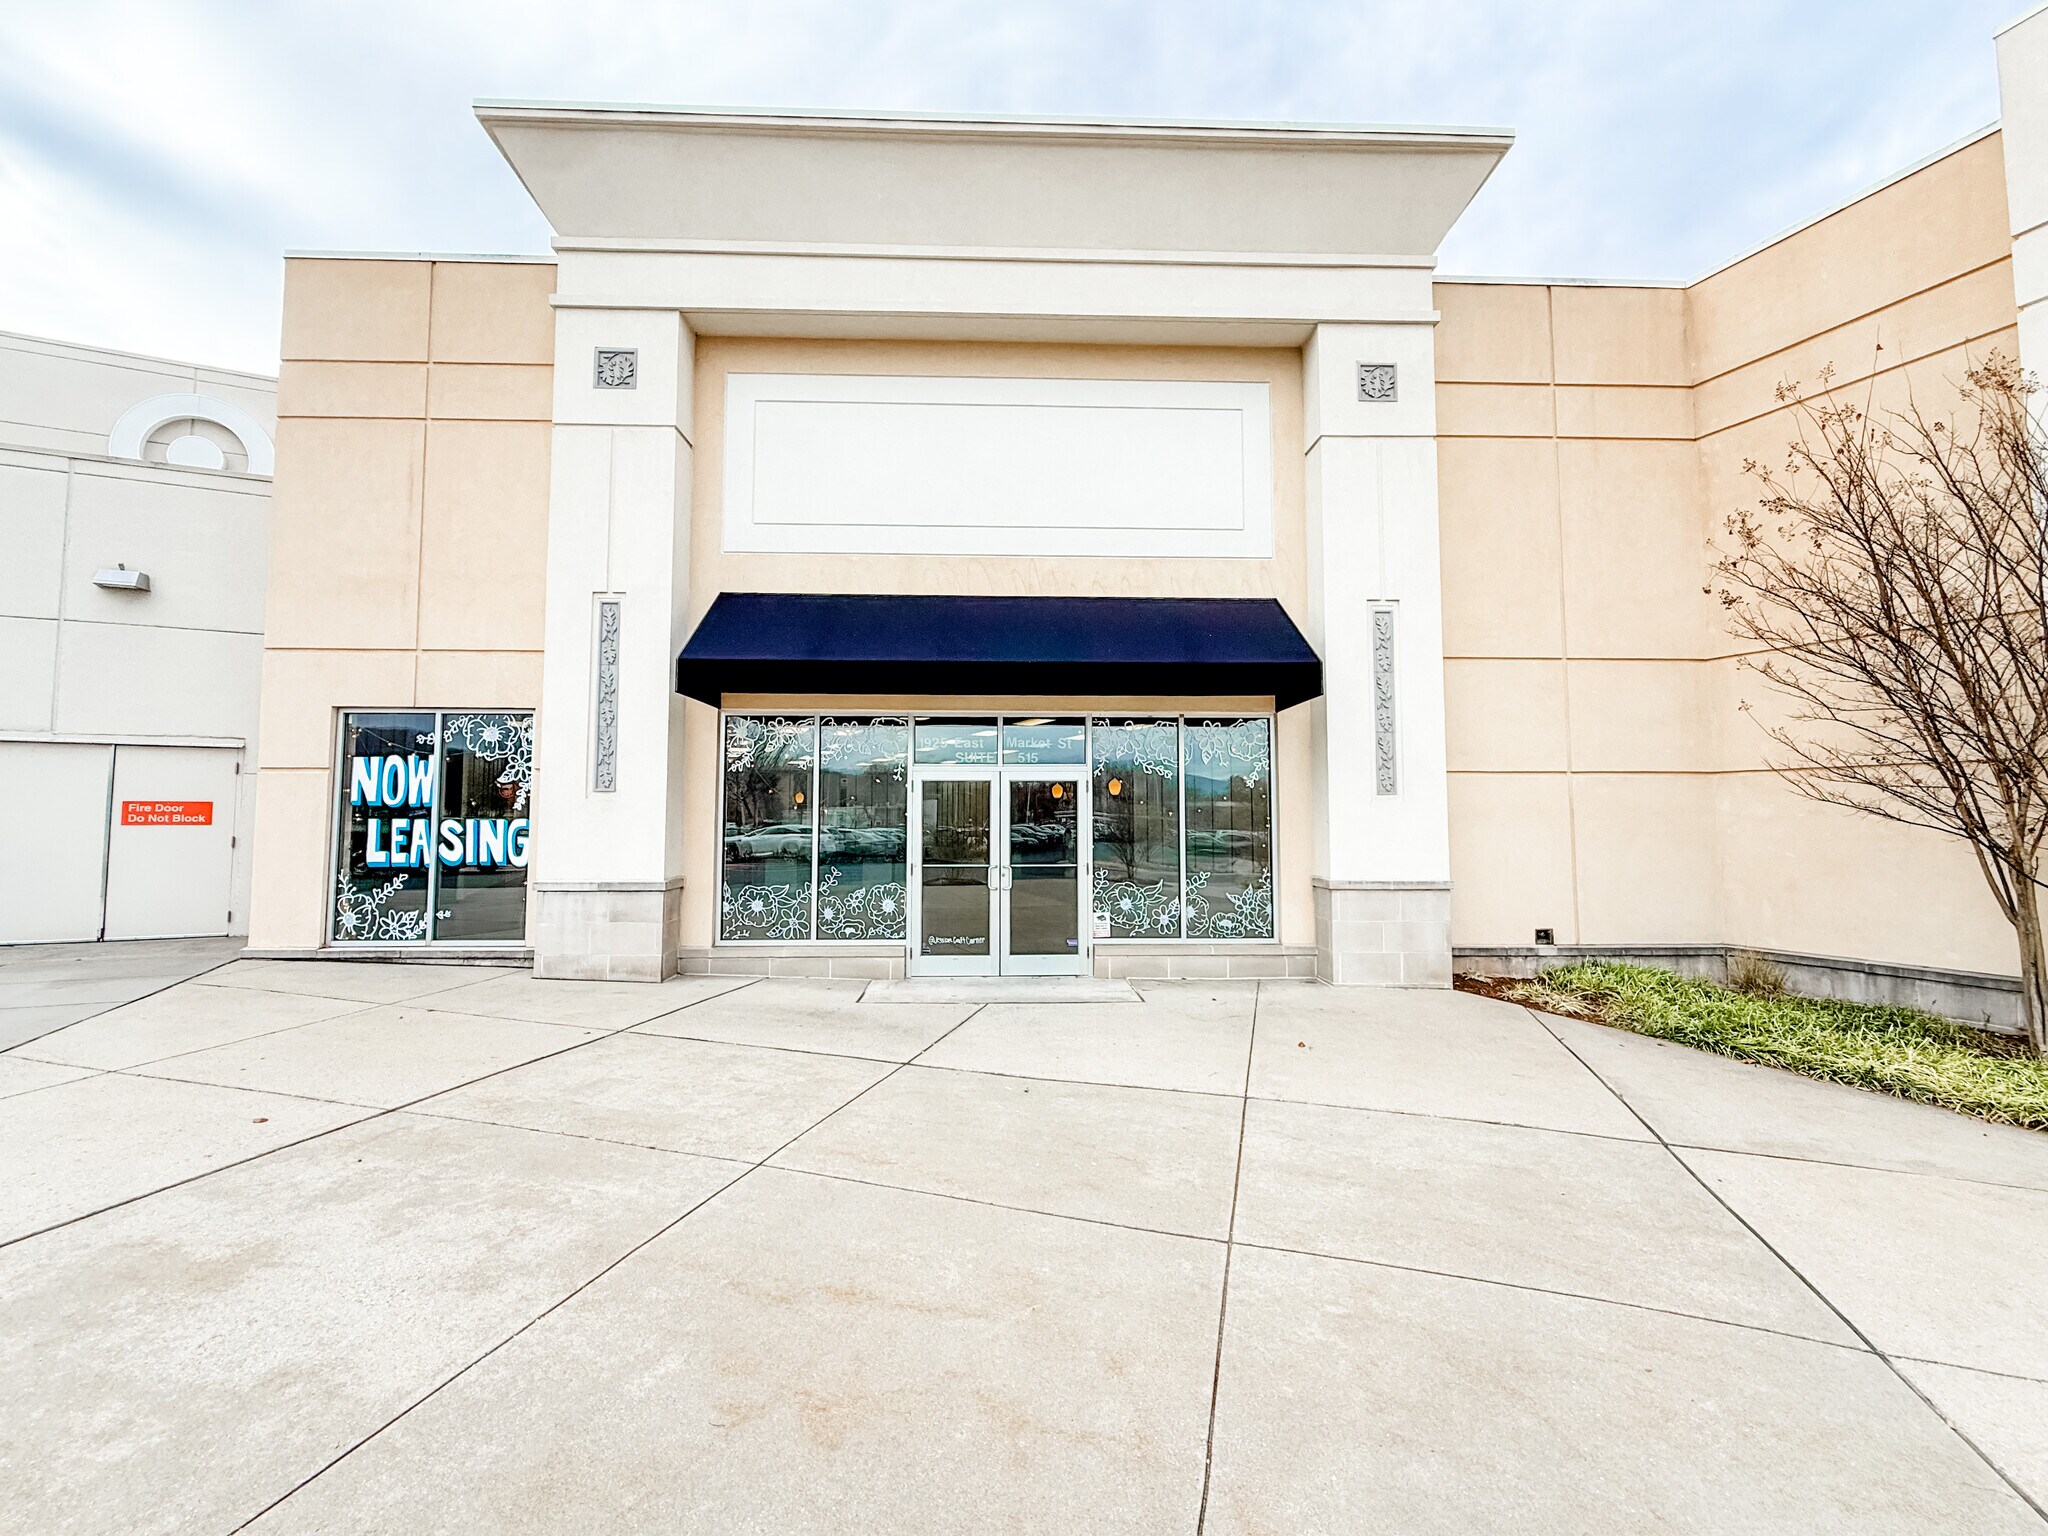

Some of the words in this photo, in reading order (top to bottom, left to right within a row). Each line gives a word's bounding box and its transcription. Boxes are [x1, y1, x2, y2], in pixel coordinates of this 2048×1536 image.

[920, 737, 948, 748] 1925
[954, 737, 984, 748] East
[1006, 736, 1053, 748] Market
[1057, 737, 1072, 749] St
[955, 751, 995, 763] SUITE
[1017, 752, 1039, 763] 515
[350, 754, 435, 808] NOW
[128, 803, 152, 812] Fire
[155, 803, 184, 812] Door
[128, 814, 145, 823] Do
[148, 814, 170, 823] Not
[172, 814, 206, 823] Block
[366, 818, 530, 869] LEASING
